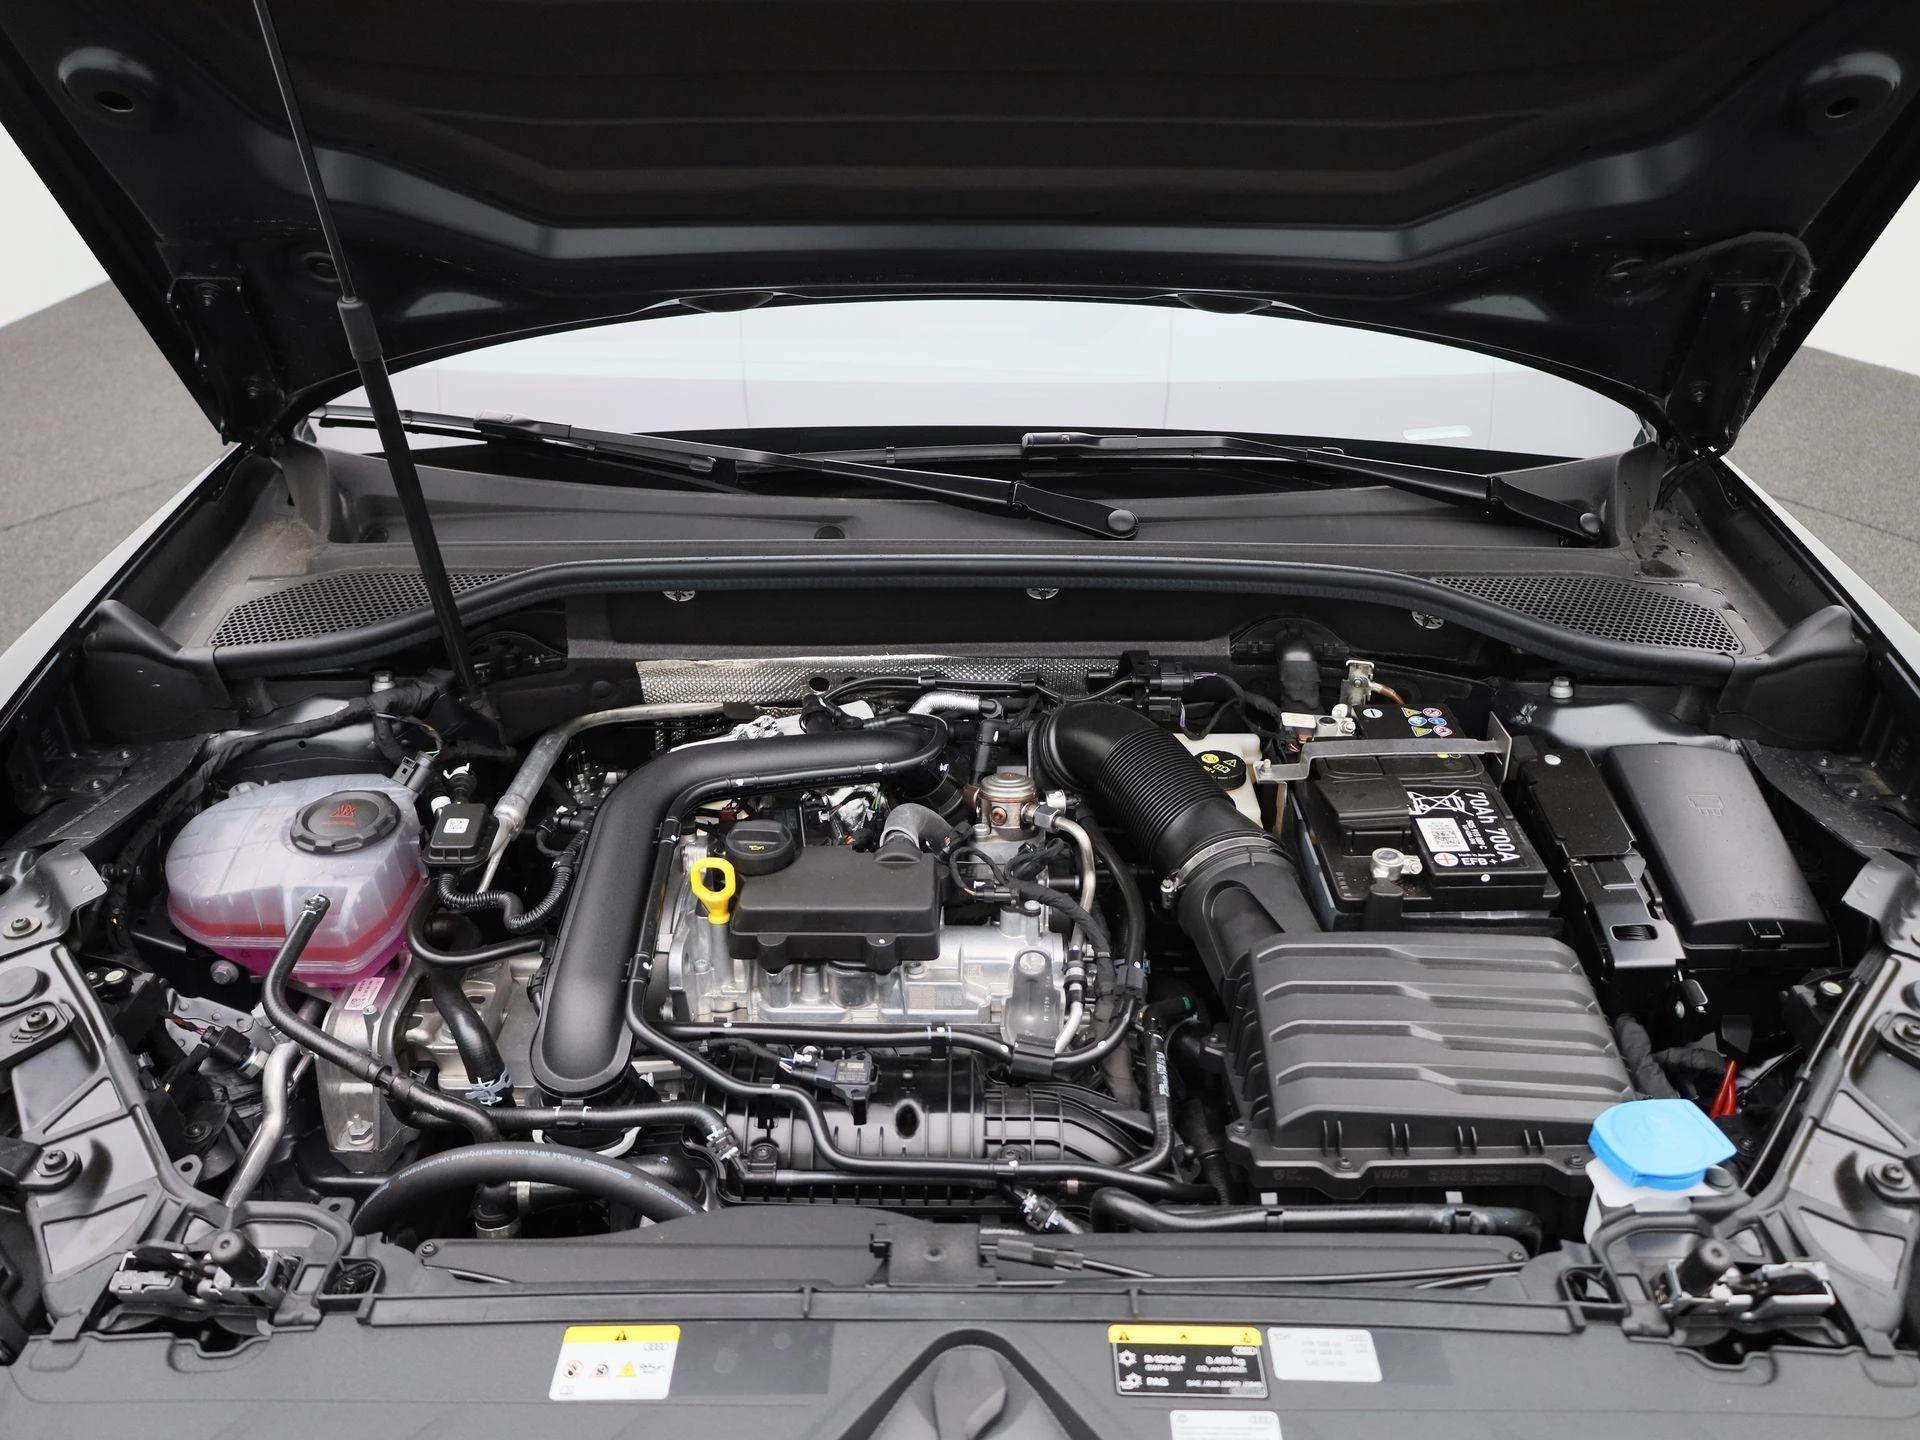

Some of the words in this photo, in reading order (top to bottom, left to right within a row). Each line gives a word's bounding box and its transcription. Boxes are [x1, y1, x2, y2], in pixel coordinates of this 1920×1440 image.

[1465, 792, 1498, 823] 70Ah
[1485, 828, 1520, 862] 700A
[1461, 857, 1488, 866] EFB
